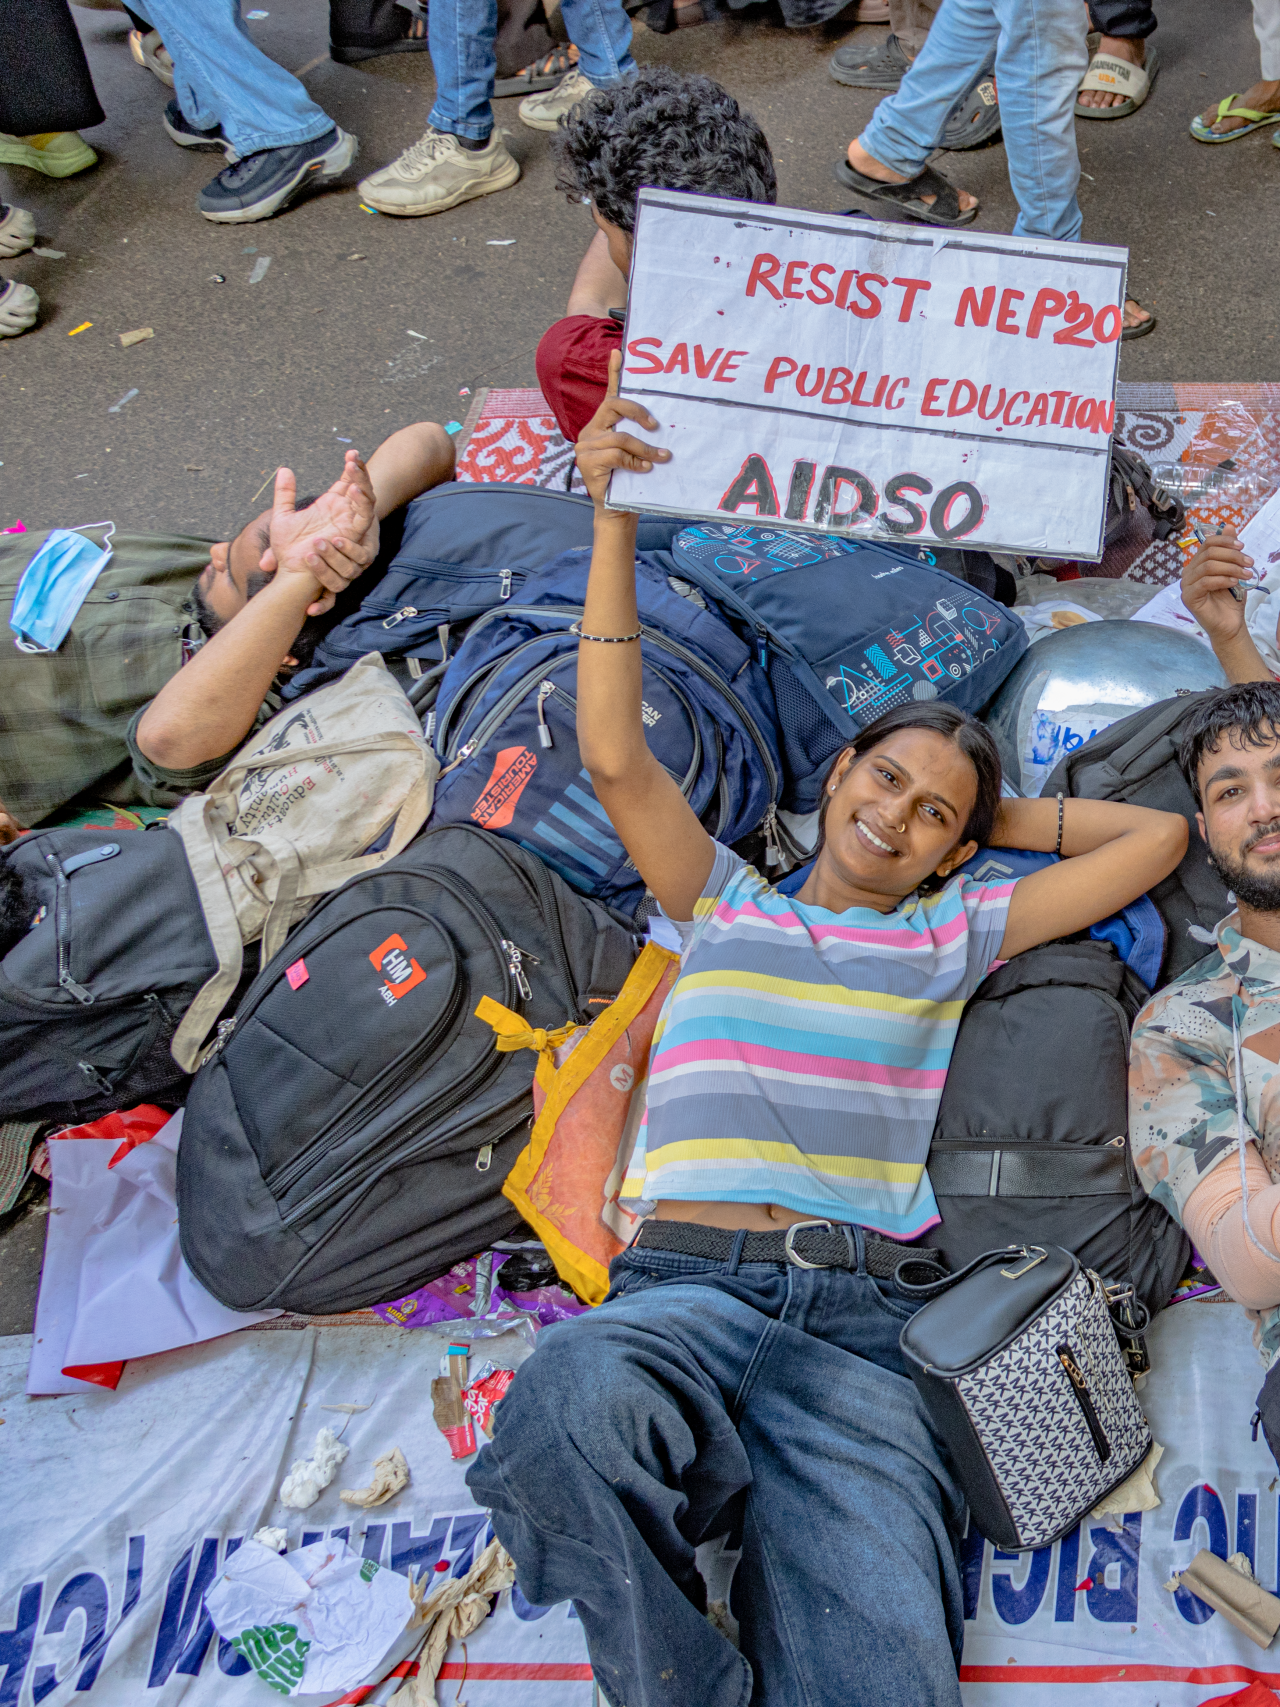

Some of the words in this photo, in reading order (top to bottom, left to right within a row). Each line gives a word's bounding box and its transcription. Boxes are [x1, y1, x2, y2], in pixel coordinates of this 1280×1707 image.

[745, 252, 932, 323] RESIST
[624, 337, 748, 383] SAVE
[764, 356, 910, 410] PUBLIC
[920, 378, 1115, 435] EDUCATION
[718, 452, 989, 541] AIDSO
[641, 701, 662, 720] CAN
[257, 776, 316, 835] Educatio
[470, 750, 533, 821] TOURISTER
[477, 754, 538, 828] AMERICAN
[382, 949, 413, 984] HM
